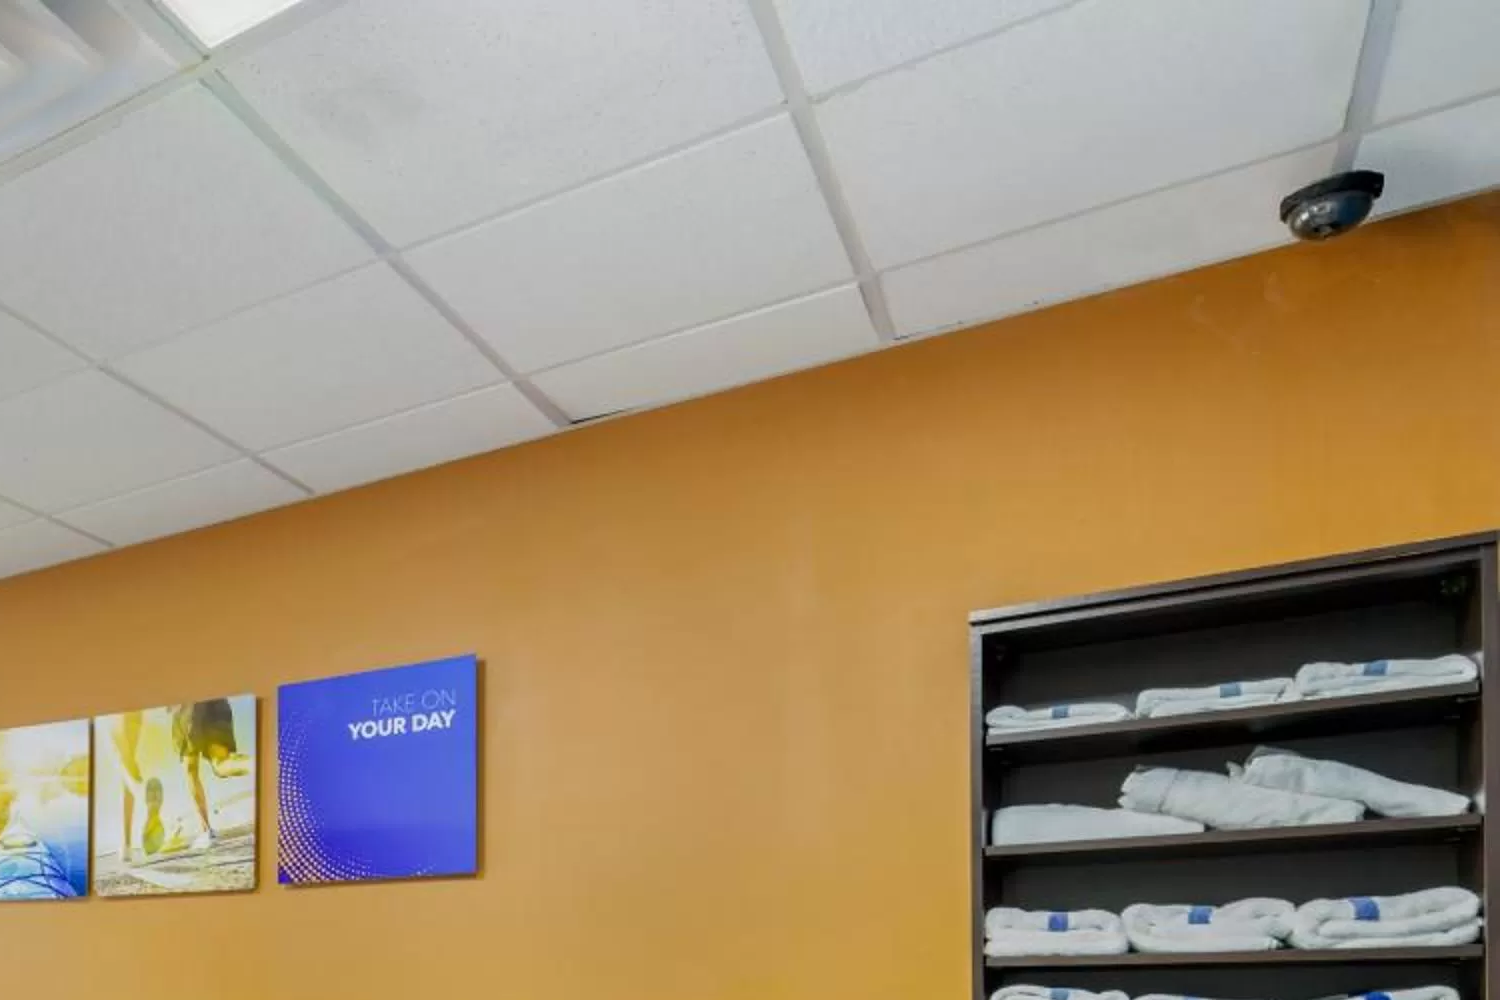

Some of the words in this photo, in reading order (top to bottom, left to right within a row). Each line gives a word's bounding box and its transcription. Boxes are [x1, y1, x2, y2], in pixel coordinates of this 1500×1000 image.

[372, 693, 415, 717] TAKE
[421, 688, 456, 710] ON
[348, 716, 406, 740] YOUR
[411, 708, 456, 732] DAY
